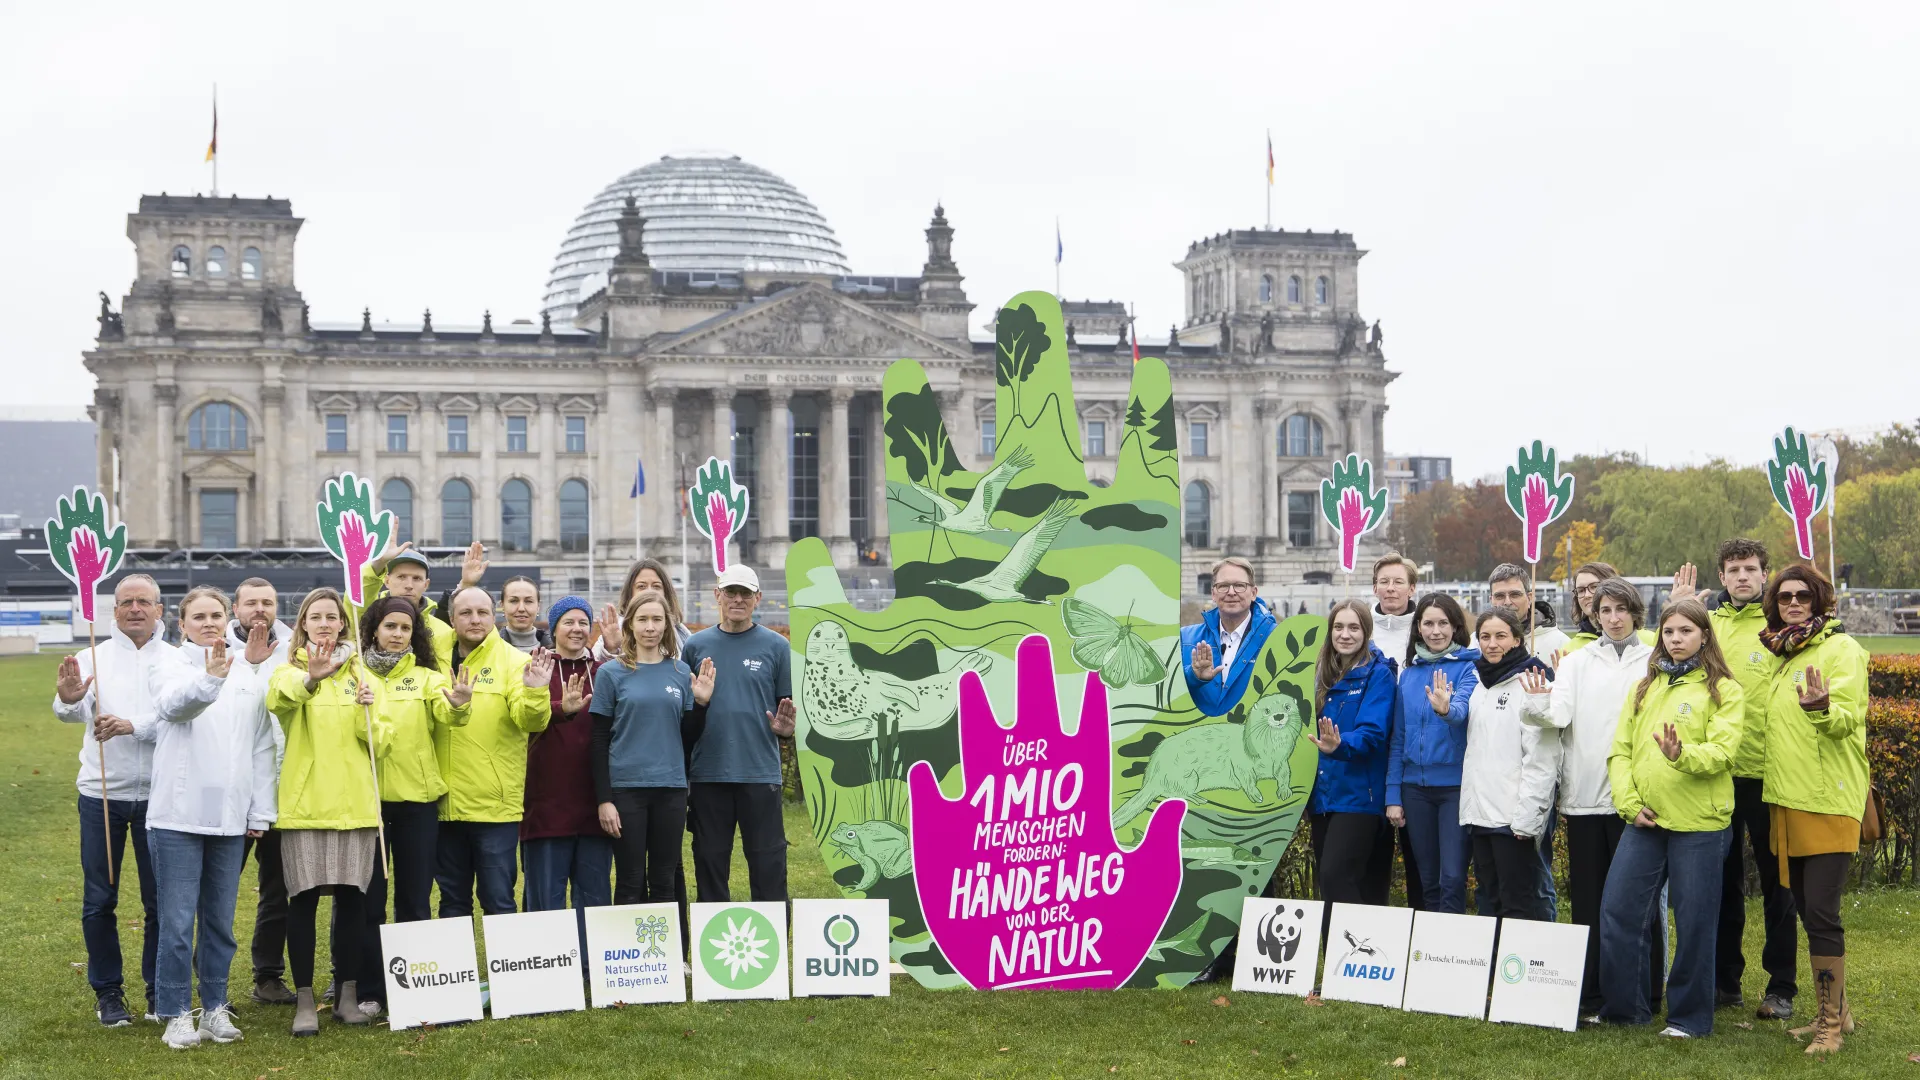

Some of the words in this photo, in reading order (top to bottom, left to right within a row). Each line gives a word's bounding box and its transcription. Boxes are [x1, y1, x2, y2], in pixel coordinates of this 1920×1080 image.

[744, 373, 768, 382] DEM
[776, 374, 837, 383] DEUTSCHEN
[846, 375, 877, 383] VOLKE
[1003, 735, 1048, 767] ÜBER
[973, 811, 1086, 851] MENSCHEN
[1003, 842, 1067, 864] FORDERN:
[948, 861, 1051, 920] HÄNDE
[1055, 852, 1125, 902] WEG
[1006, 910, 1036, 931] VON
[1041, 903, 1075, 926] DER
[604, 949, 641, 961] BUND
[988, 917, 1103, 983] NATUR
[410, 961, 439, 976] PRO
[490, 953, 572, 973] ClientEarth
[605, 962, 667, 975] Naturschutz
[806, 958, 879, 977] BUND
[1343, 963, 1395, 981] NABU
[1528, 967, 1559, 977] DEUTSCHER
[1530, 959, 1545, 967] DNR
[412, 970, 475, 989] WILDLIFE
[606, 978, 616, 988] in
[617, 976, 651, 989] Bayern
[653, 972, 669, 984] e.V.
[1253, 967, 1296, 985] WWF
[1527, 975, 1577, 987] NATURSCHUTZRING
